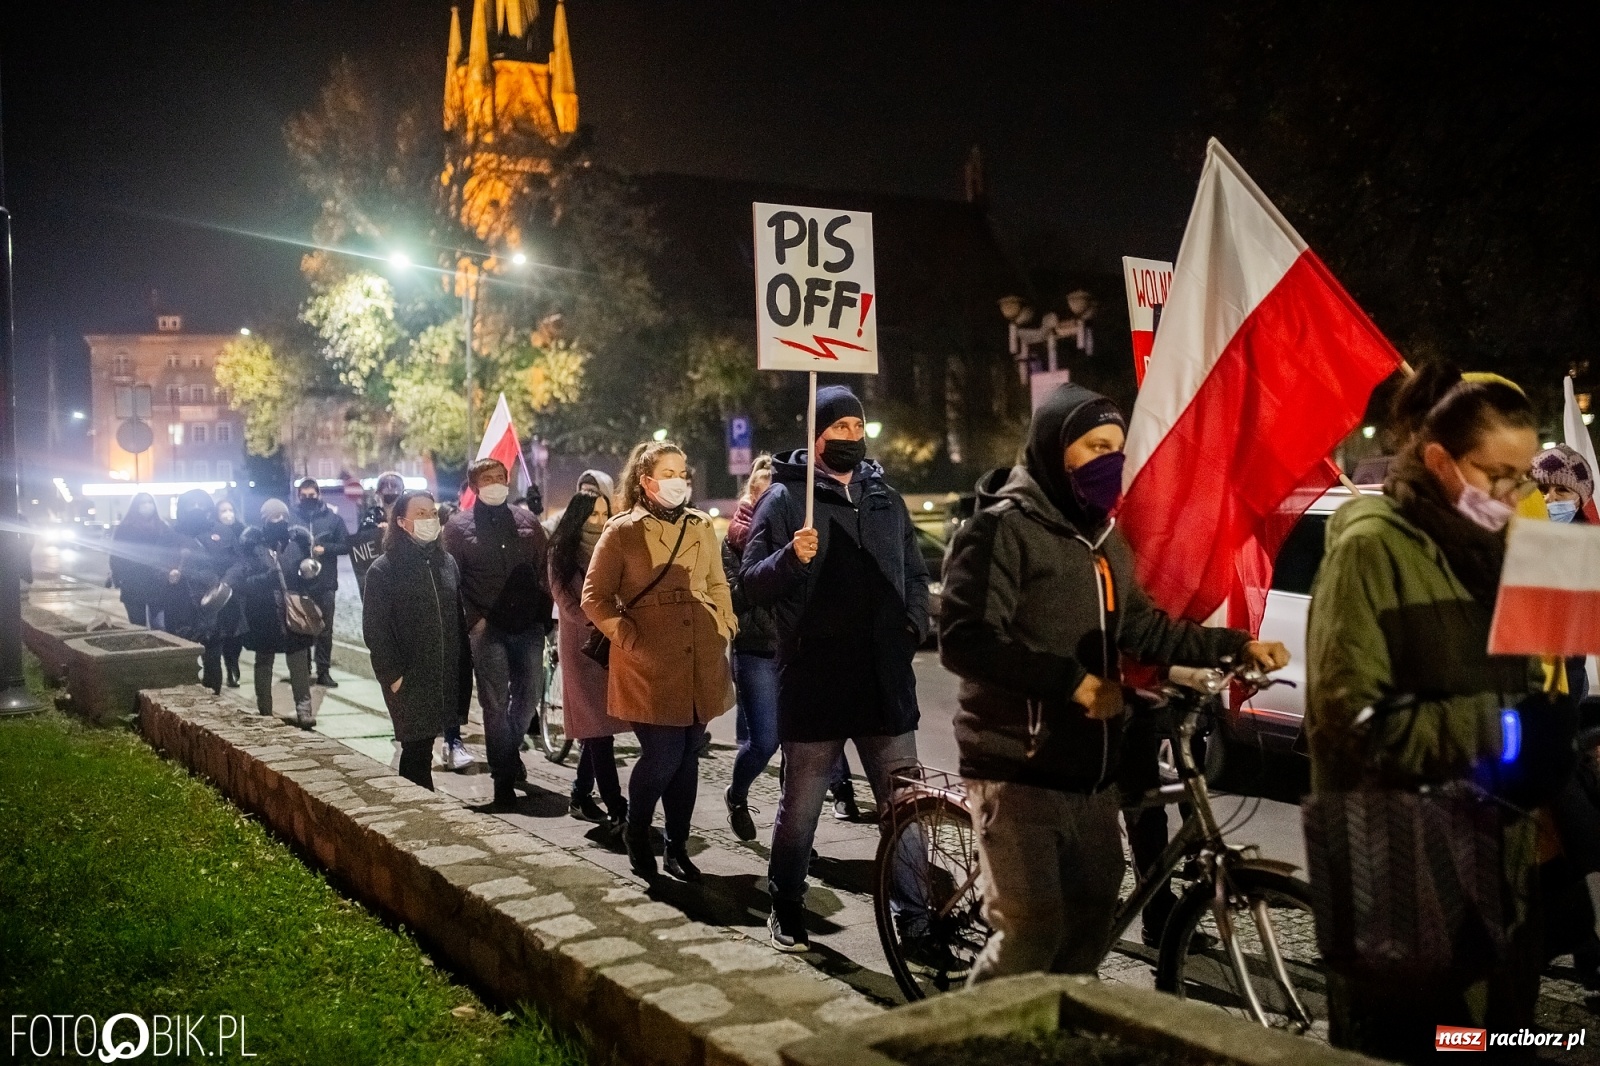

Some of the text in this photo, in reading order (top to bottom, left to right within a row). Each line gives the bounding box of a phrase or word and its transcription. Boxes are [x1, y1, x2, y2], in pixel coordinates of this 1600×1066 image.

[767, 211, 854, 273] PIS
[766, 273, 874, 338] OFF!
[732, 418, 747, 440] P
[352, 540, 379, 563] NIE
